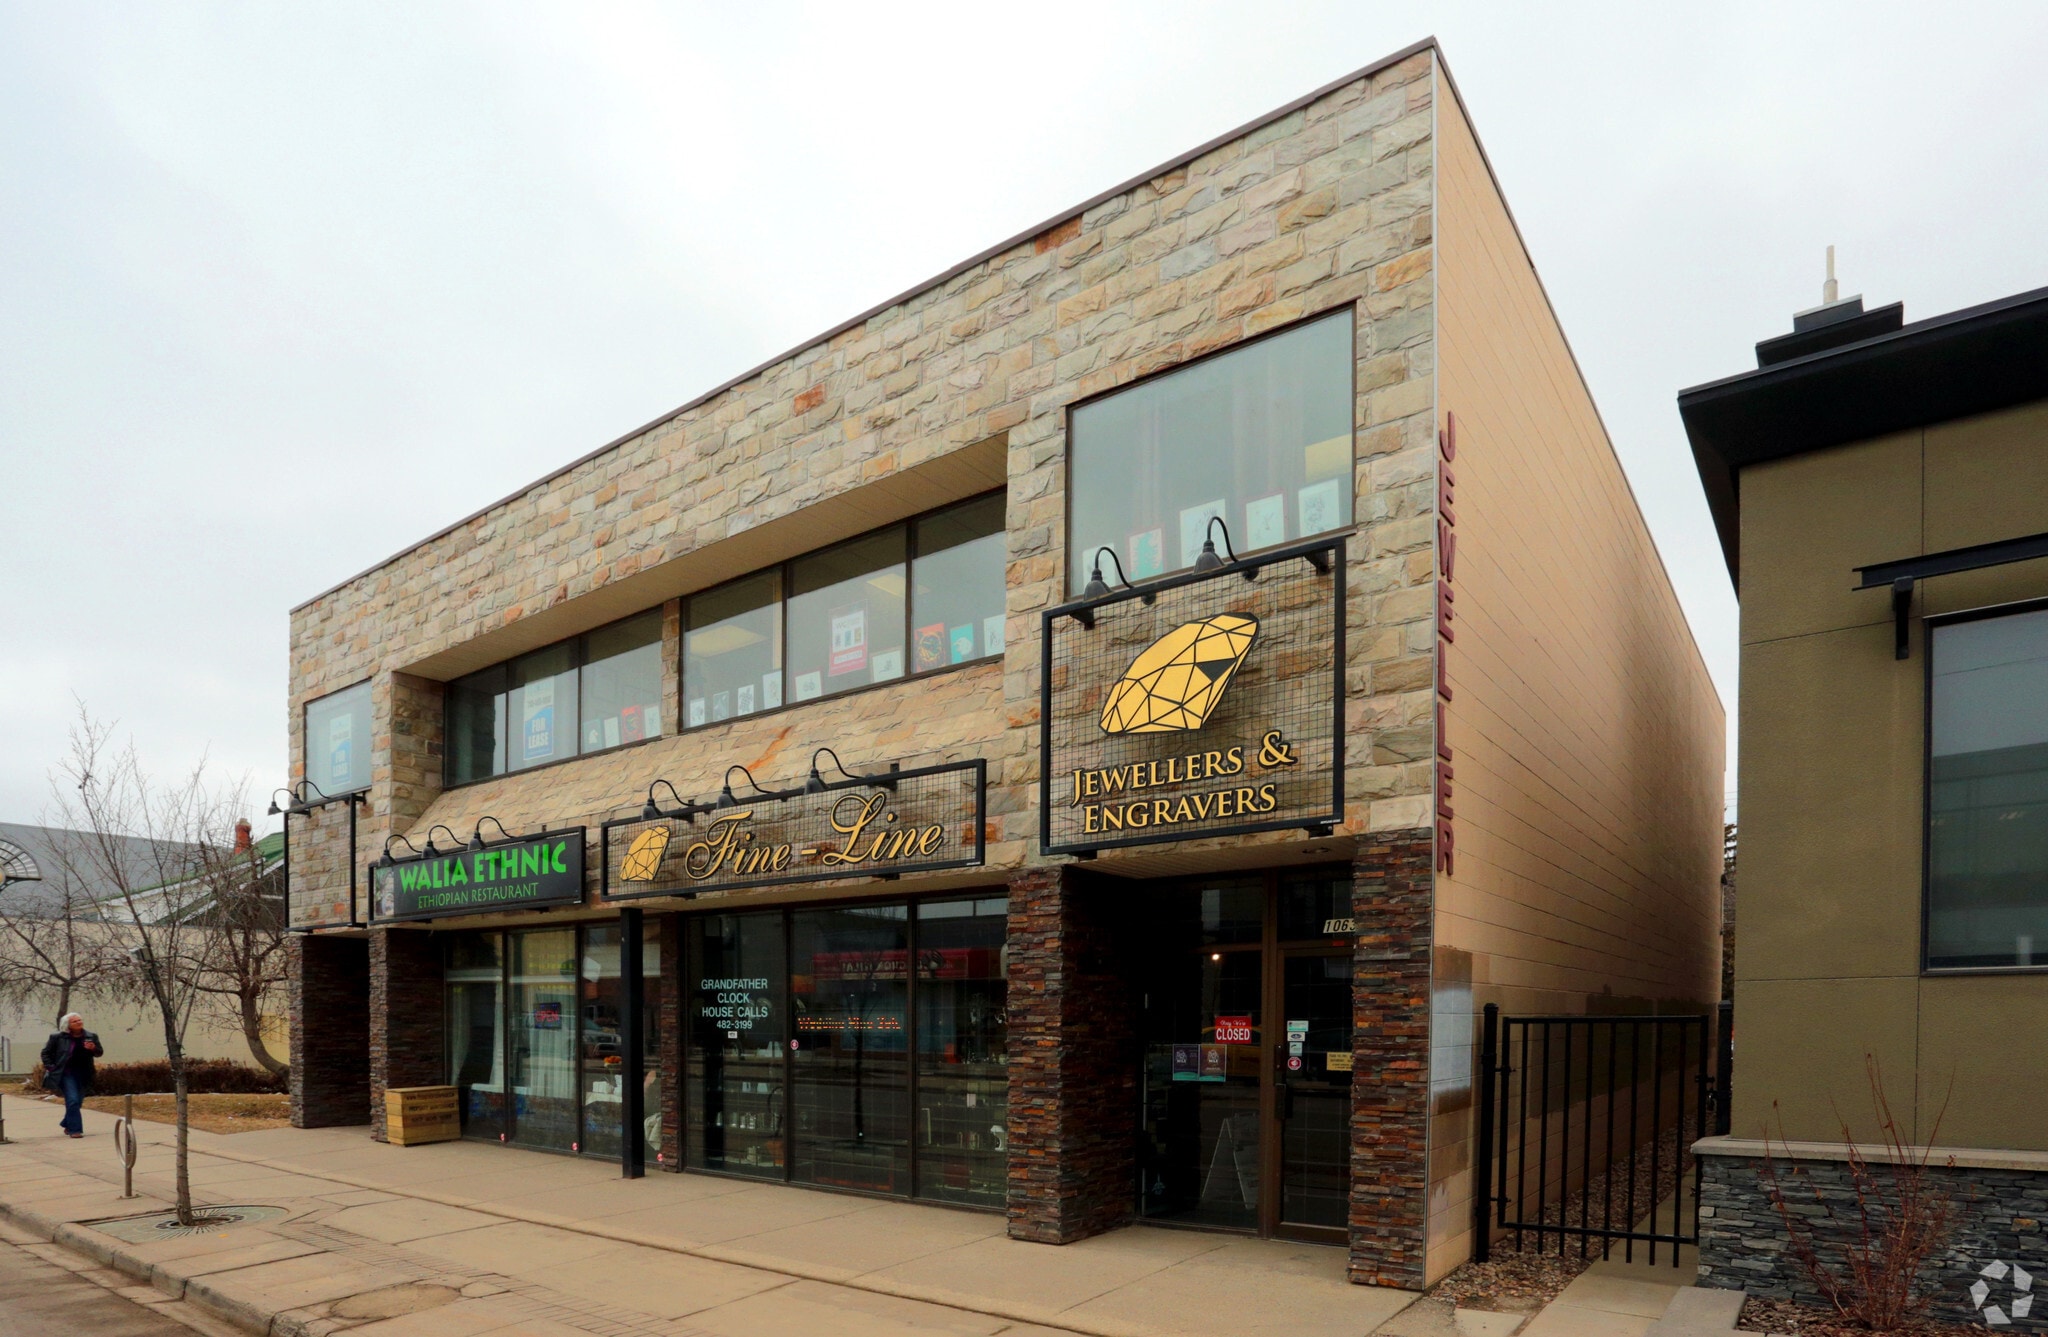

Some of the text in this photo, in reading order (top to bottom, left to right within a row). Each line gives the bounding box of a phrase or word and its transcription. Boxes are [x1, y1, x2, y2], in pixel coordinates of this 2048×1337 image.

[1437, 410, 1457, 876] JEWELLER
[528, 732, 549, 750] LEASE
[1071, 729, 1298, 806] JEWELLERS &
[1082, 784, 1277, 835] ENGRAVERS
[684, 810, 792, 880] Fine
[822, 791, 945, 866] Line
[400, 841, 567, 894] WALIA ETHNIC
[417, 882, 539, 909] ETHIOPIAN RESTAURANT
[701, 979, 768, 990] GRANDFATHER
[717, 992, 750, 1004] CLOCK
[702, 1006, 769, 1018] HOUSE CALLS
[716, 1020, 753, 1030] 482-3199
[1216, 1028, 1250, 1041] CLOSED
